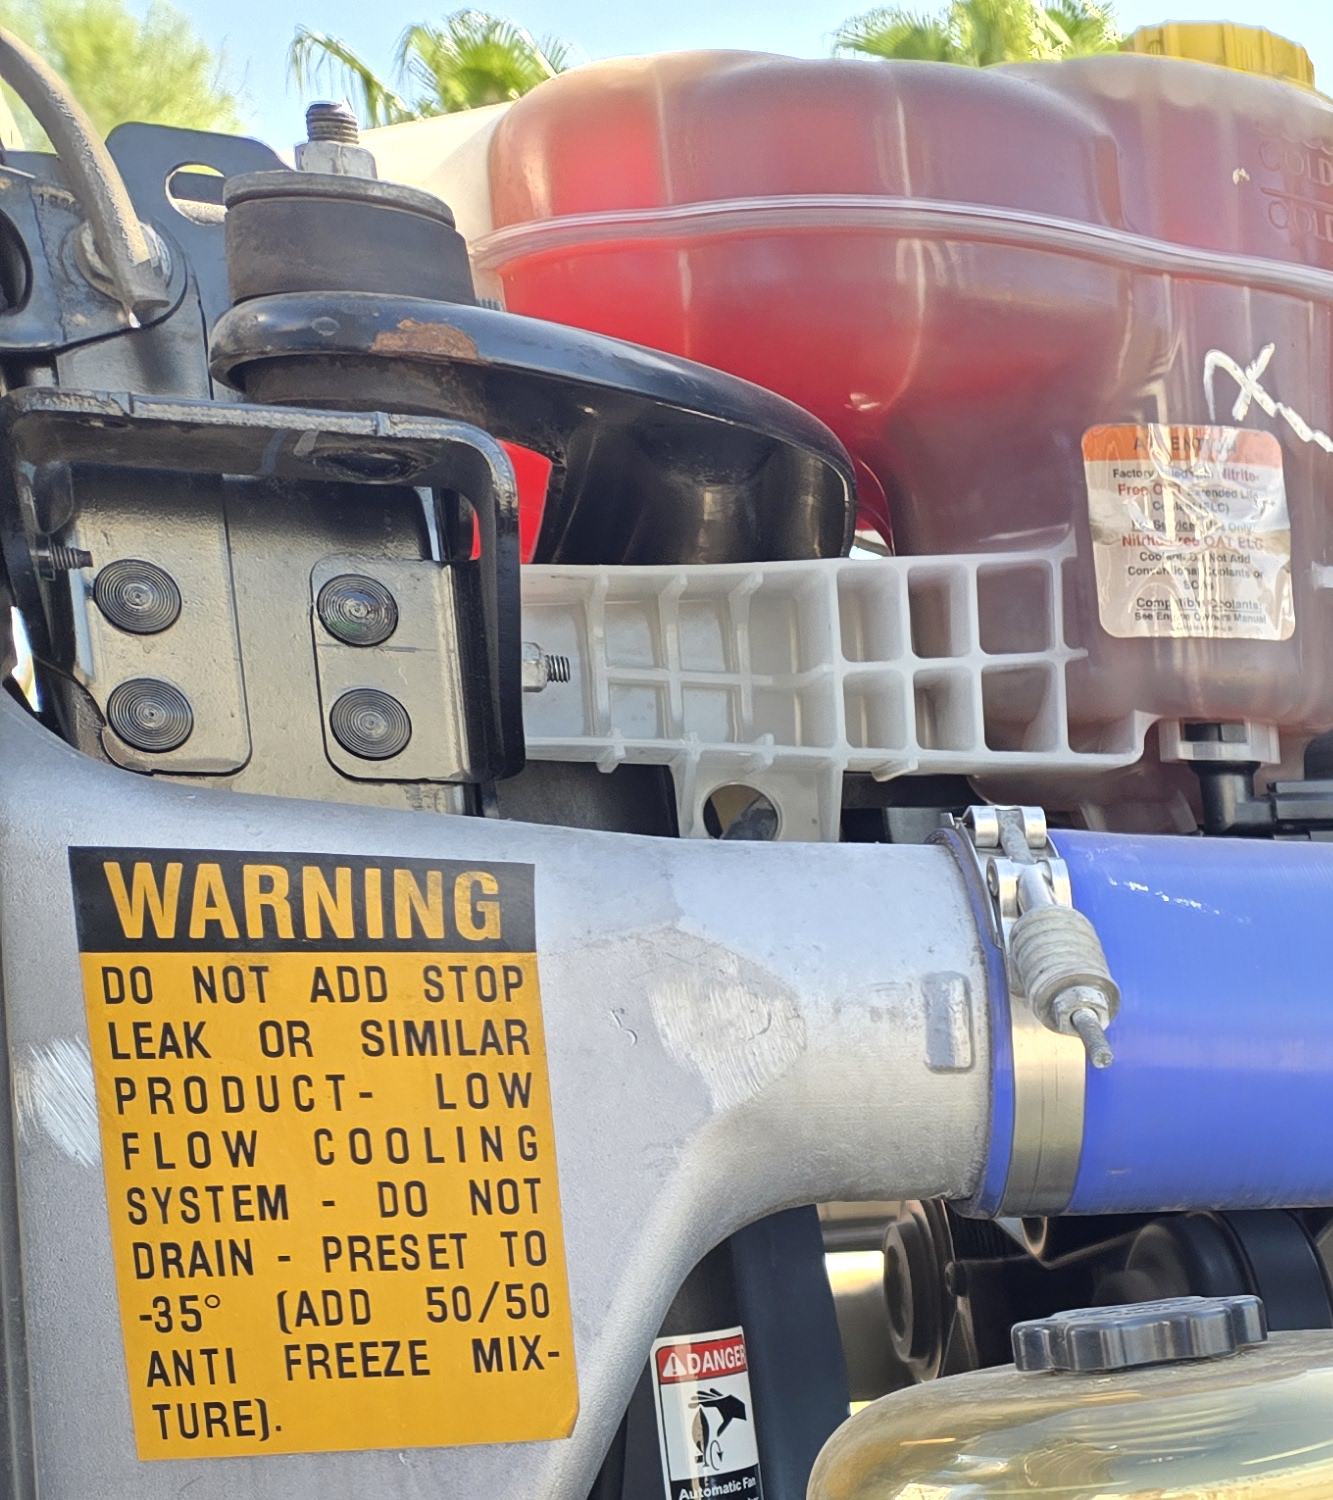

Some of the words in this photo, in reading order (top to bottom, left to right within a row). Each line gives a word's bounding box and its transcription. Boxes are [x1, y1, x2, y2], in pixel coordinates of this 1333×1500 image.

[104, 862, 500, 941] WARNING
[103, 966, 153, 1004] DO
[194, 965, 270, 1004] NOT
[311, 966, 388, 1003] ADD
[424, 965, 524, 1003] STOP
[108, 1021, 212, 1060] LEAK
[260, 1020, 313, 1058] OR
[361, 1019, 530, 1057] SIMILAR
[116, 1074, 373, 1115] PRODUCT-
[436, 1072, 532, 1110] LOW
[122, 1130, 257, 1170] FLOW
[314, 1125, 538, 1166] COOLING
[127, 1184, 289, 1225] SYSTEM
[378, 1180, 428, 1218] DO
[471, 1177, 541, 1216] NOT
[134, 1238, 254, 1279] DRAIN
[323, 1233, 467, 1273] PRESET
[500, 1229, 547, 1267] TO
[139, 1294, 221, 1334] -35°
[278, 1288, 372, 1334] (ADD
[426, 1281, 550, 1323] 50/50
[147, 1348, 236, 1388] ANTI
[285, 1340, 429, 1381] FREEZE
[472, 1336, 560, 1374] MIX-
[686, 1344, 746, 1375] DANGER
[679, 1481, 741, 1500] Automatic
[743, 1477, 757, 1489] Fan
